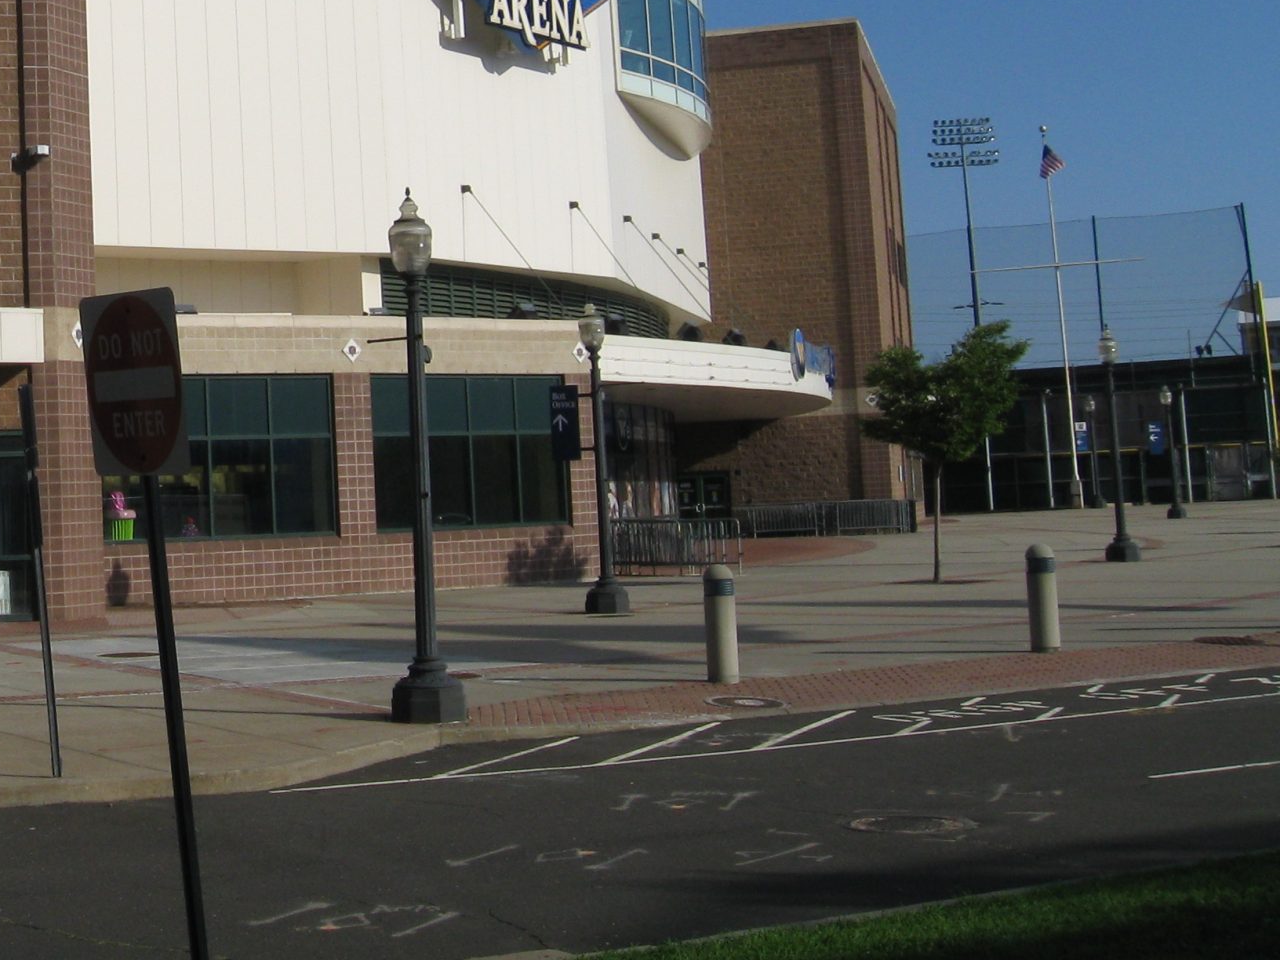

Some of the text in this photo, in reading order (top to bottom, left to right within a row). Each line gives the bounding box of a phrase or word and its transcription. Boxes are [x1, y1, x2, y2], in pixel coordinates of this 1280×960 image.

[98, 328, 164, 359] DO NOT
[112, 410, 167, 439] ENTER
